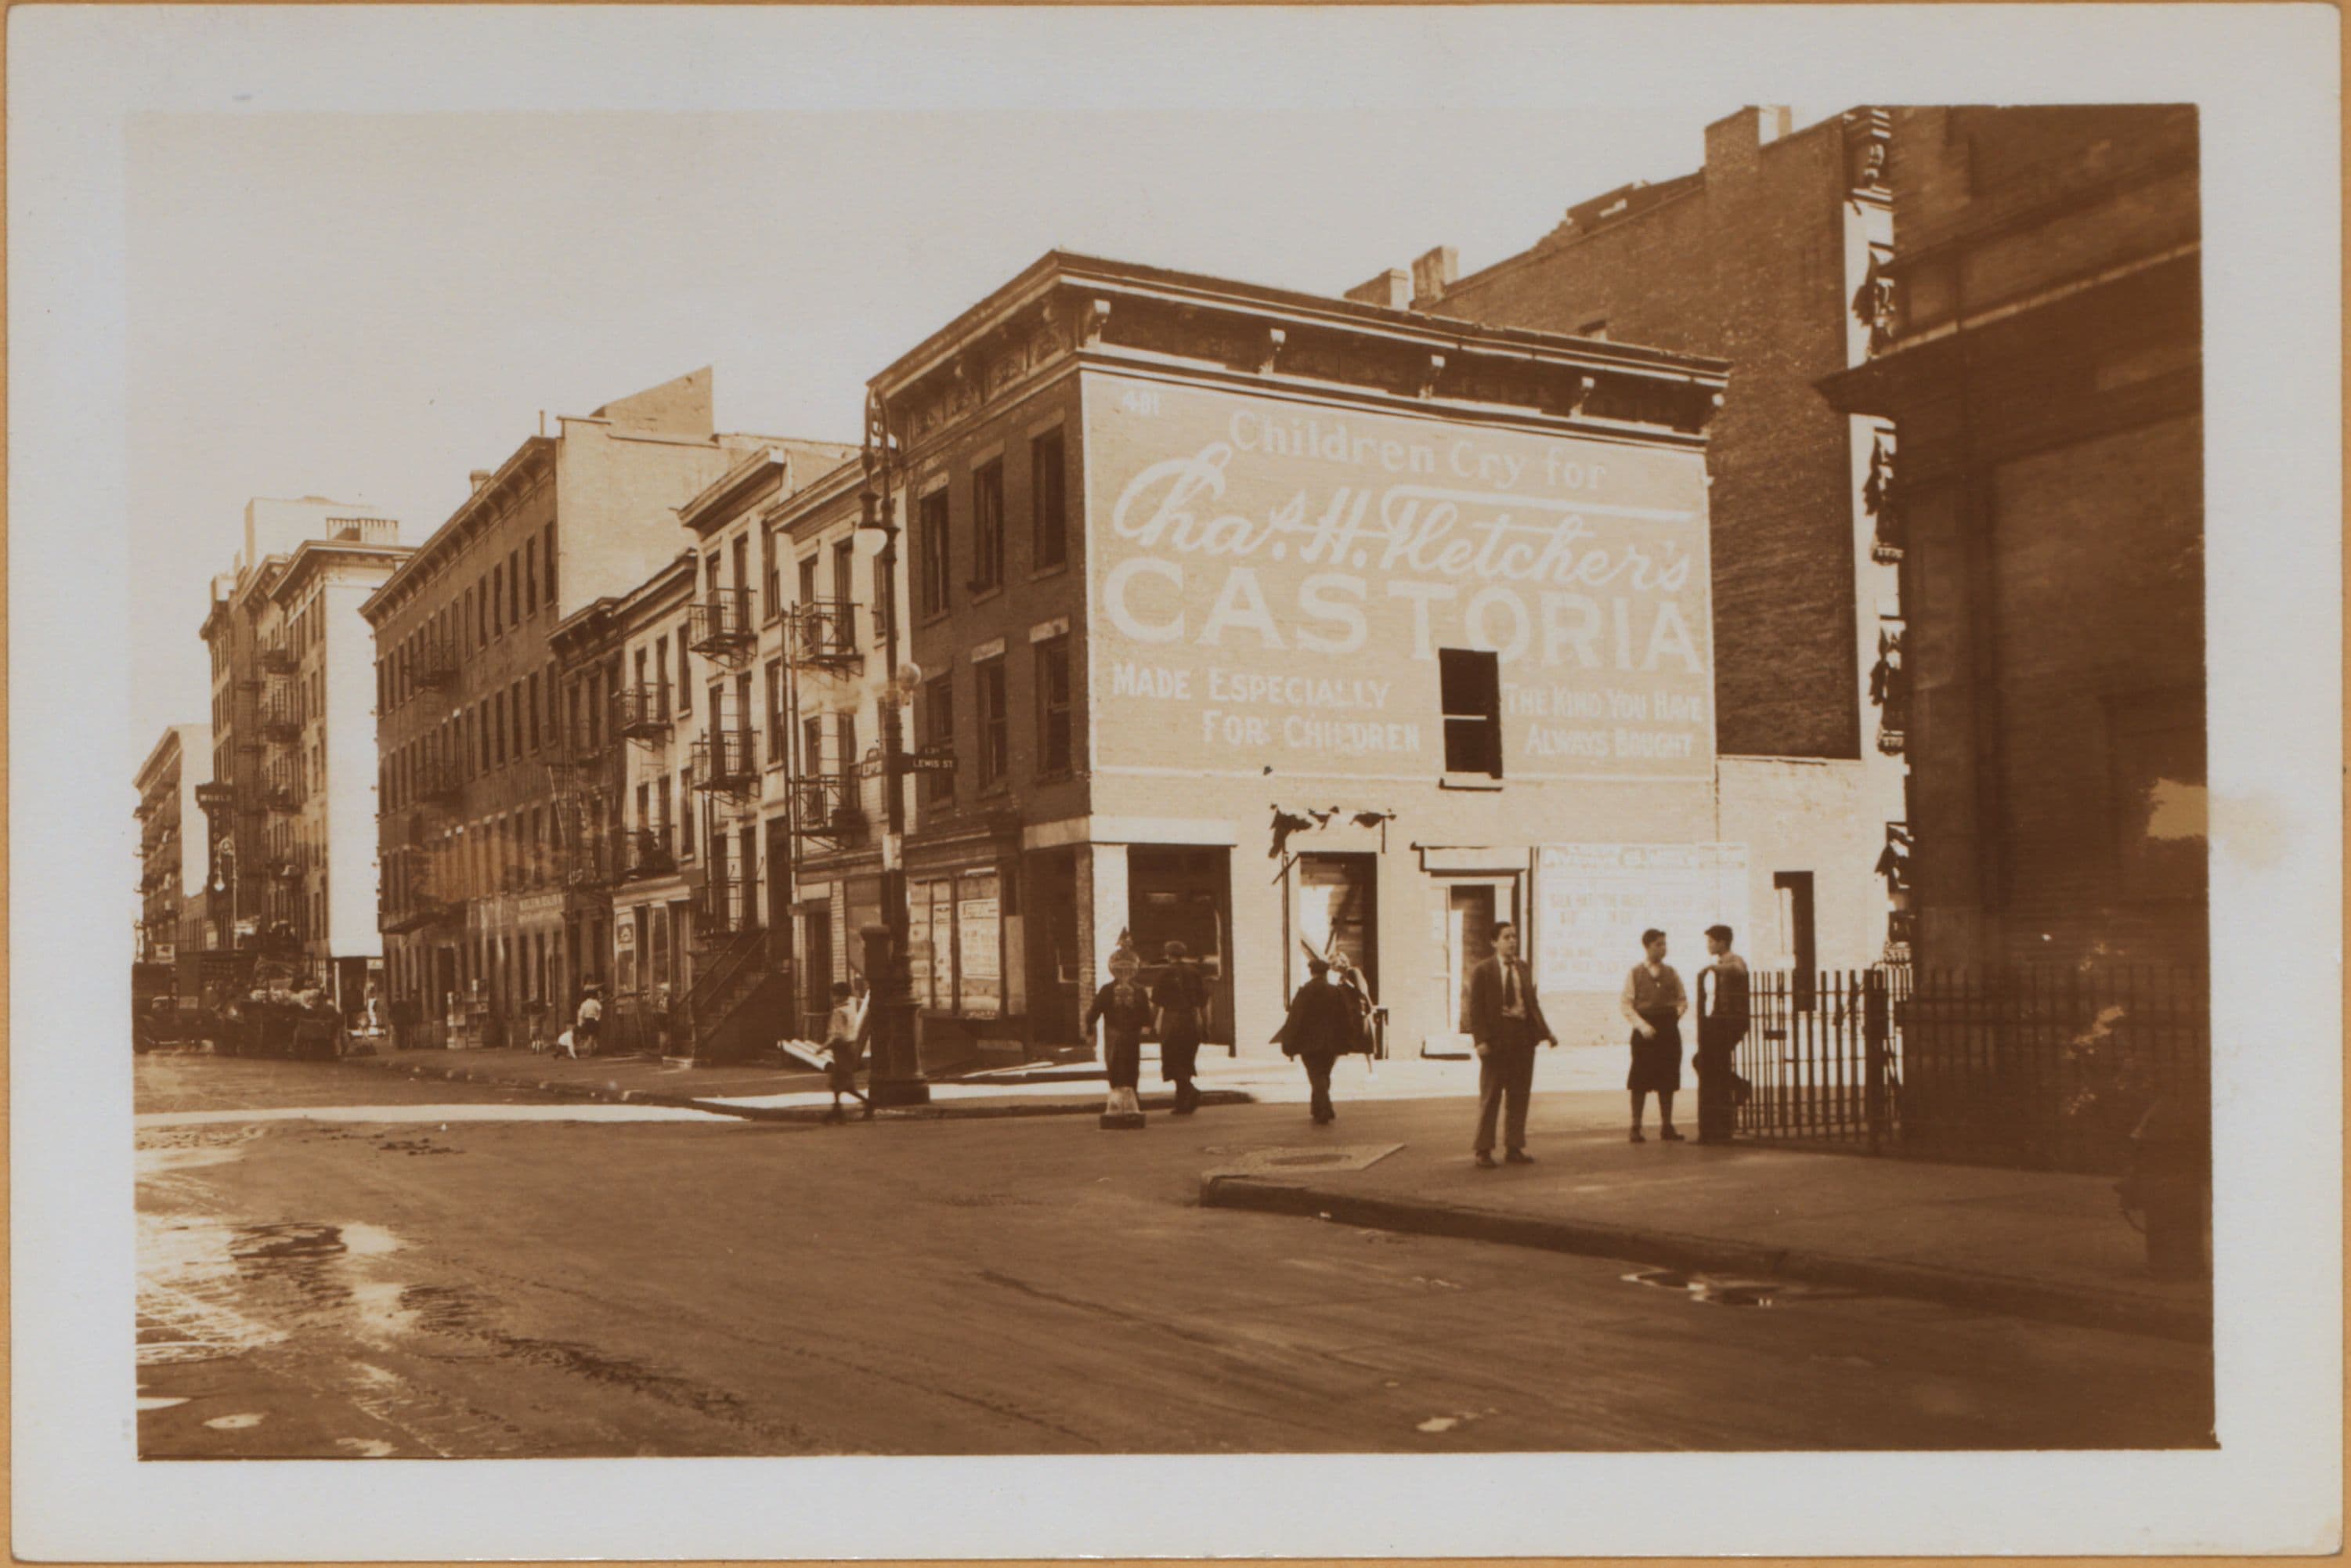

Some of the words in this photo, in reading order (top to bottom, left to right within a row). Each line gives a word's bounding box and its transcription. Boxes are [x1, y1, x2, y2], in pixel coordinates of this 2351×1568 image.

[1230, 409, 1435, 473] Children
[1449, 440, 1524, 490] Cry
[1546, 446, 1606, 490] for
[1381, 484, 1693, 592] Fletcher's
[1103, 557, 1706, 675] CASTORIA
[1112, 663, 1192, 701] MADE
[1208, 667, 1392, 709] ESPECIALLY
[1502, 682, 1549, 716] THE
[1552, 686, 1602, 719] KIND
[1605, 688, 1649, 721] YOU
[1652, 689, 1703, 724] HAVE
[1203, 709, 1272, 747] FOR
[1283, 712, 1420, 754] CHILDREN
[1525, 722, 1607, 757] ALWAYS
[1614, 726, 1693, 758] BOUGHT
[912, 758, 940, 768] LEWIS
